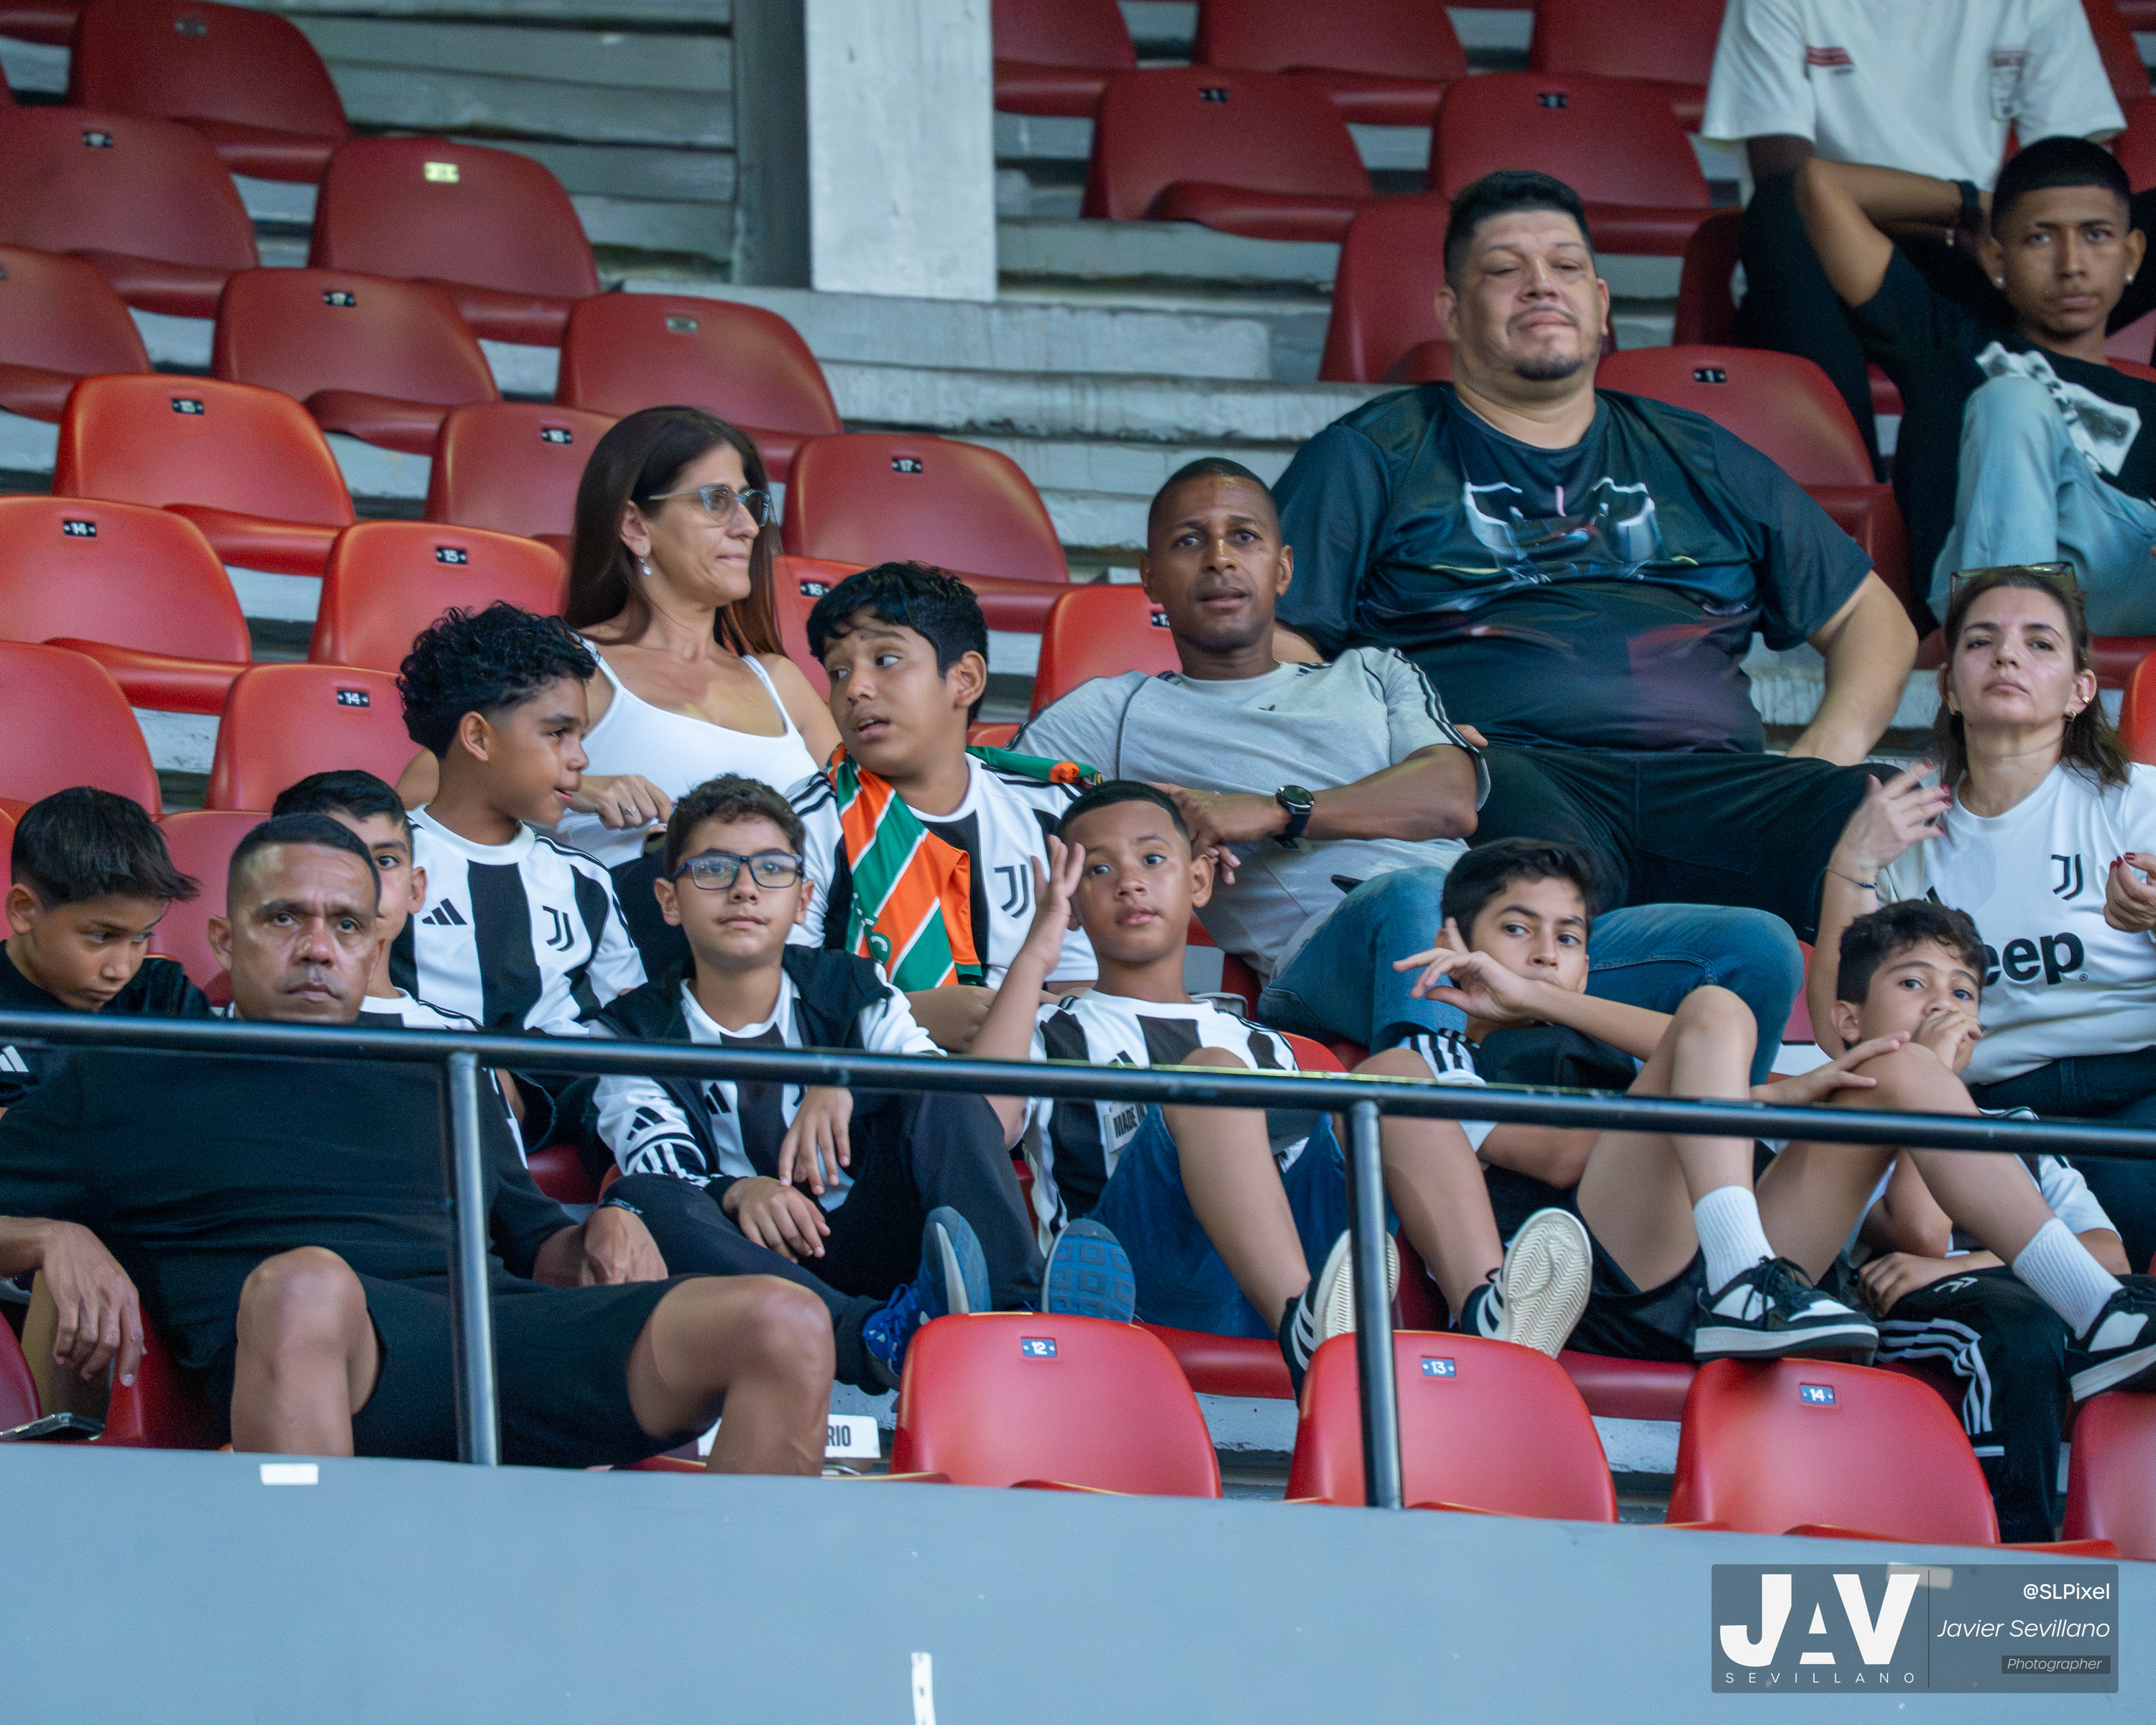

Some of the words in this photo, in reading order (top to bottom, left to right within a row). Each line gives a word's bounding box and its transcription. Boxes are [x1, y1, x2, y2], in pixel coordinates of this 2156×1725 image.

[71, 523, 86, 535] 14
[443, 550, 458, 562] 15
[807, 583, 823, 596] 16
[344, 692, 360, 704] 14
[1031, 1340, 1048, 1355] 12
[1431, 1361, 1447, 1375] 13
[1810, 1388, 1826, 1402] 14
